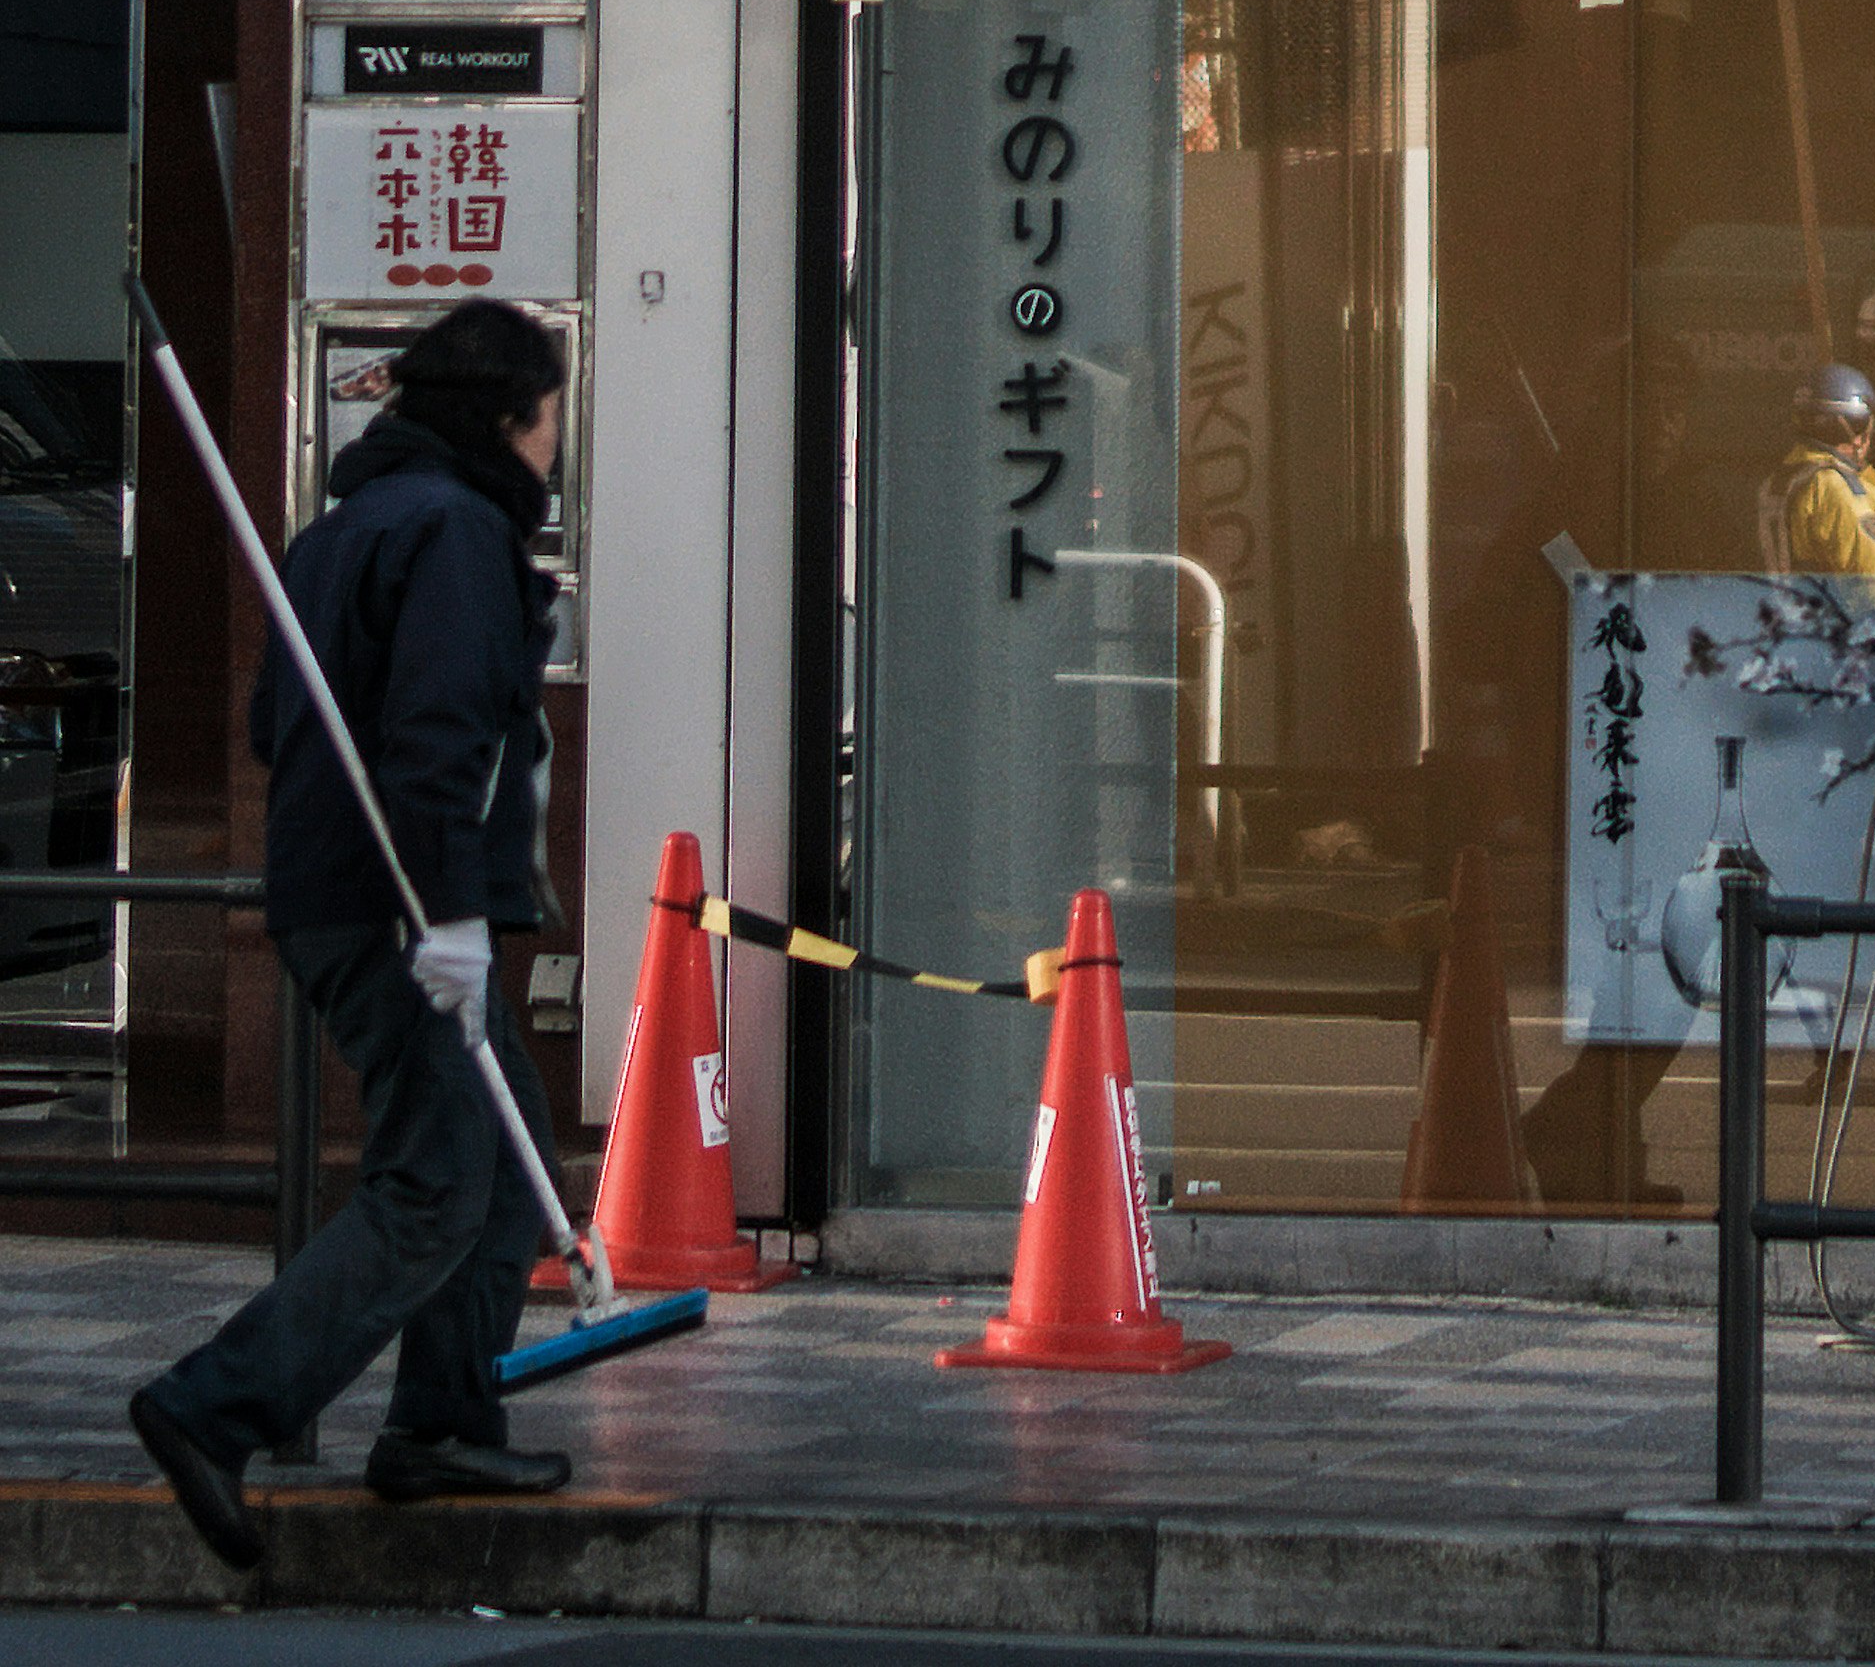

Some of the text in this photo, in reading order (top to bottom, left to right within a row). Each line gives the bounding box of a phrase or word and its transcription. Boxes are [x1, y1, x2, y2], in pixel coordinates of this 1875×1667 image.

[420, 51, 457, 67] REAL
[458, 51, 531, 67] WORKOUT
[375, 120, 423, 256] 六本木
[1000, 34, 1077, 600] みのりのギフト
